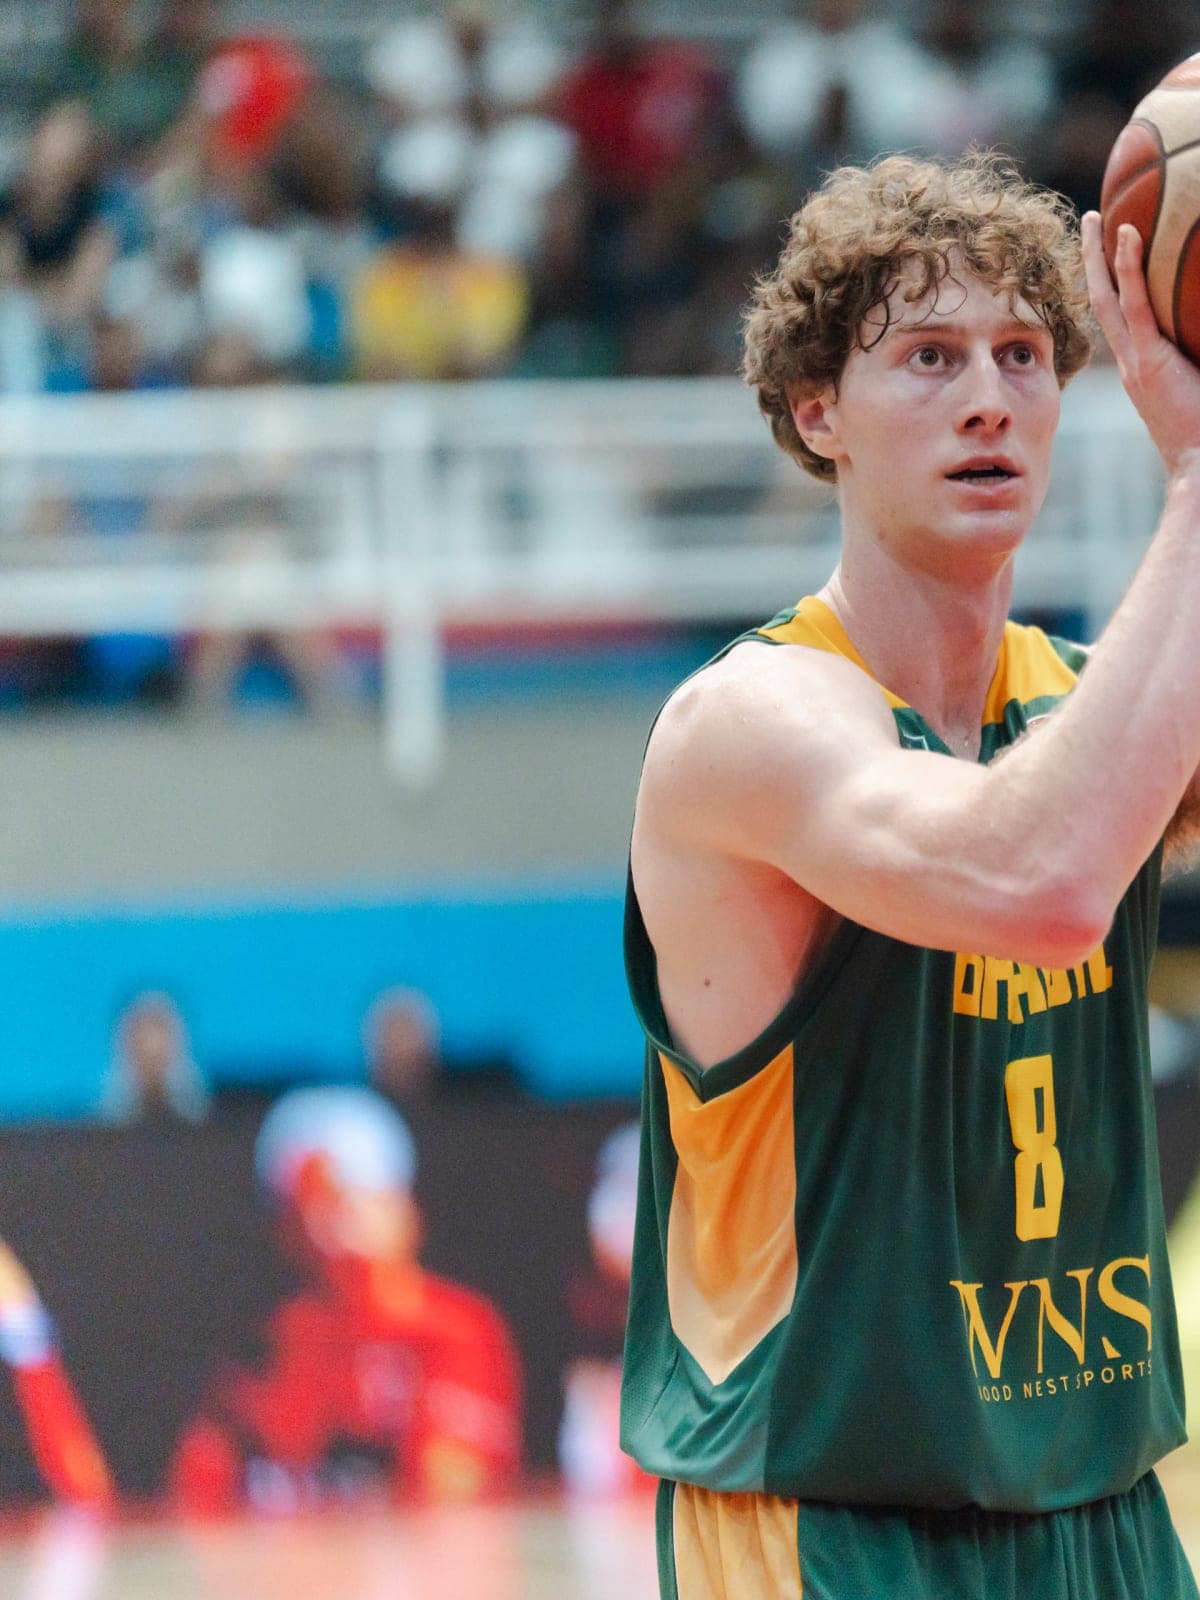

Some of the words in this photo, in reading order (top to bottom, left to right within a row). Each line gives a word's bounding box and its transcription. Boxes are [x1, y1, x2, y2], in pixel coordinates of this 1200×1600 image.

[1004, 1054, 1065, 1242] 8
[978, 1384, 1012, 1402] OOD
[1023, 1375, 1069, 1399] NEST
